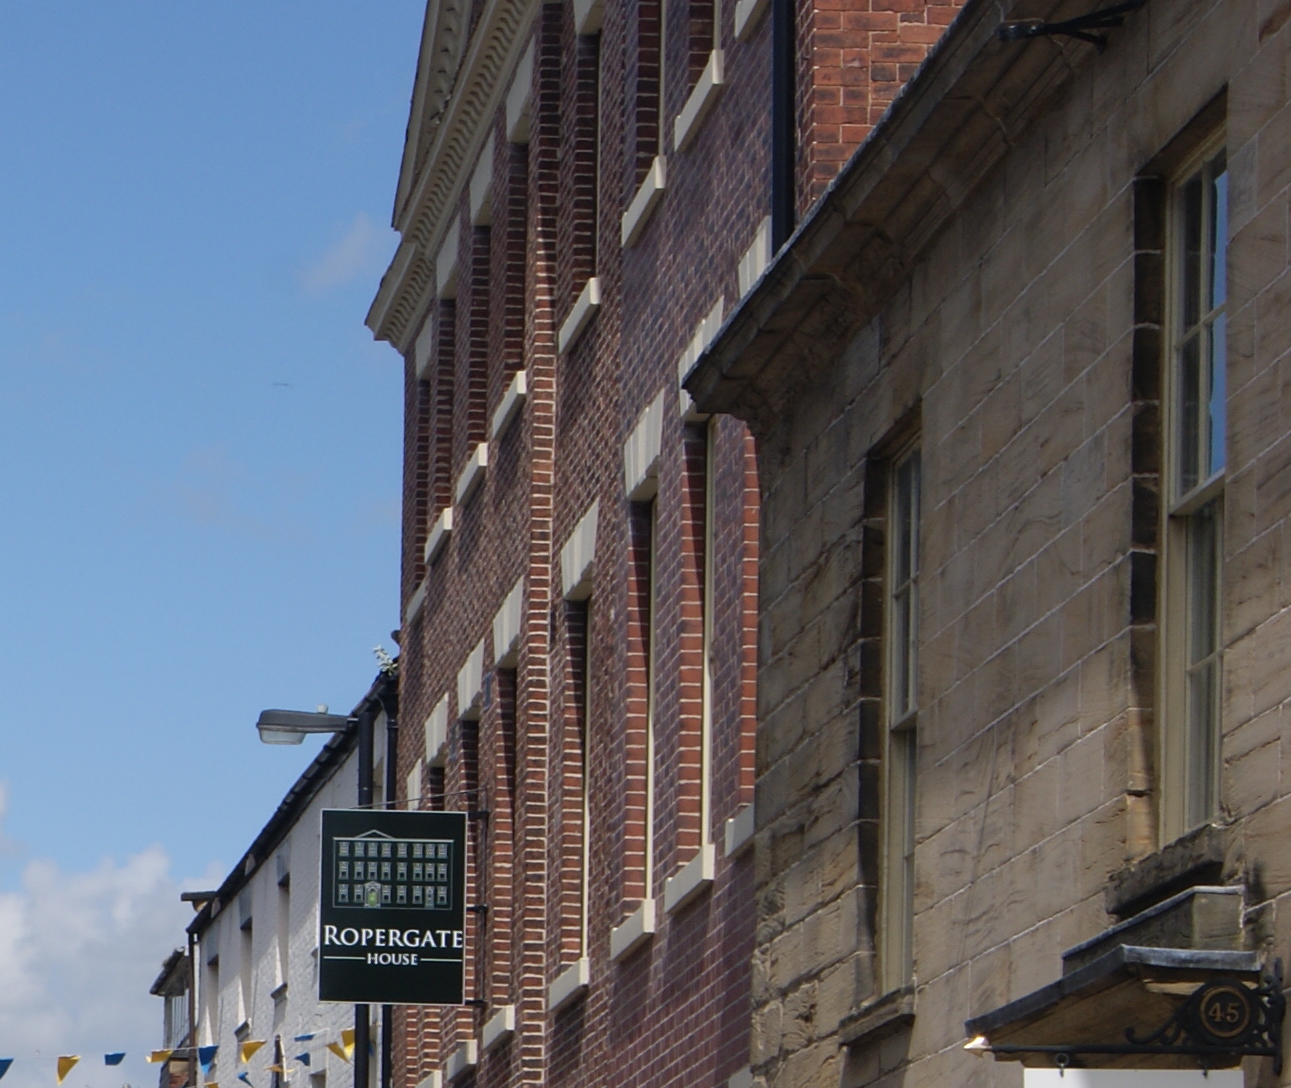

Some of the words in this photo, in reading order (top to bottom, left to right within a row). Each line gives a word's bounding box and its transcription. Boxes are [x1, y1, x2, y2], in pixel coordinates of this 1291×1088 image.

[323, 925, 463, 949] ROPERGATE
[367, 953, 418, 966] HOUSE
[1208, 1002, 1239, 1024] 45
